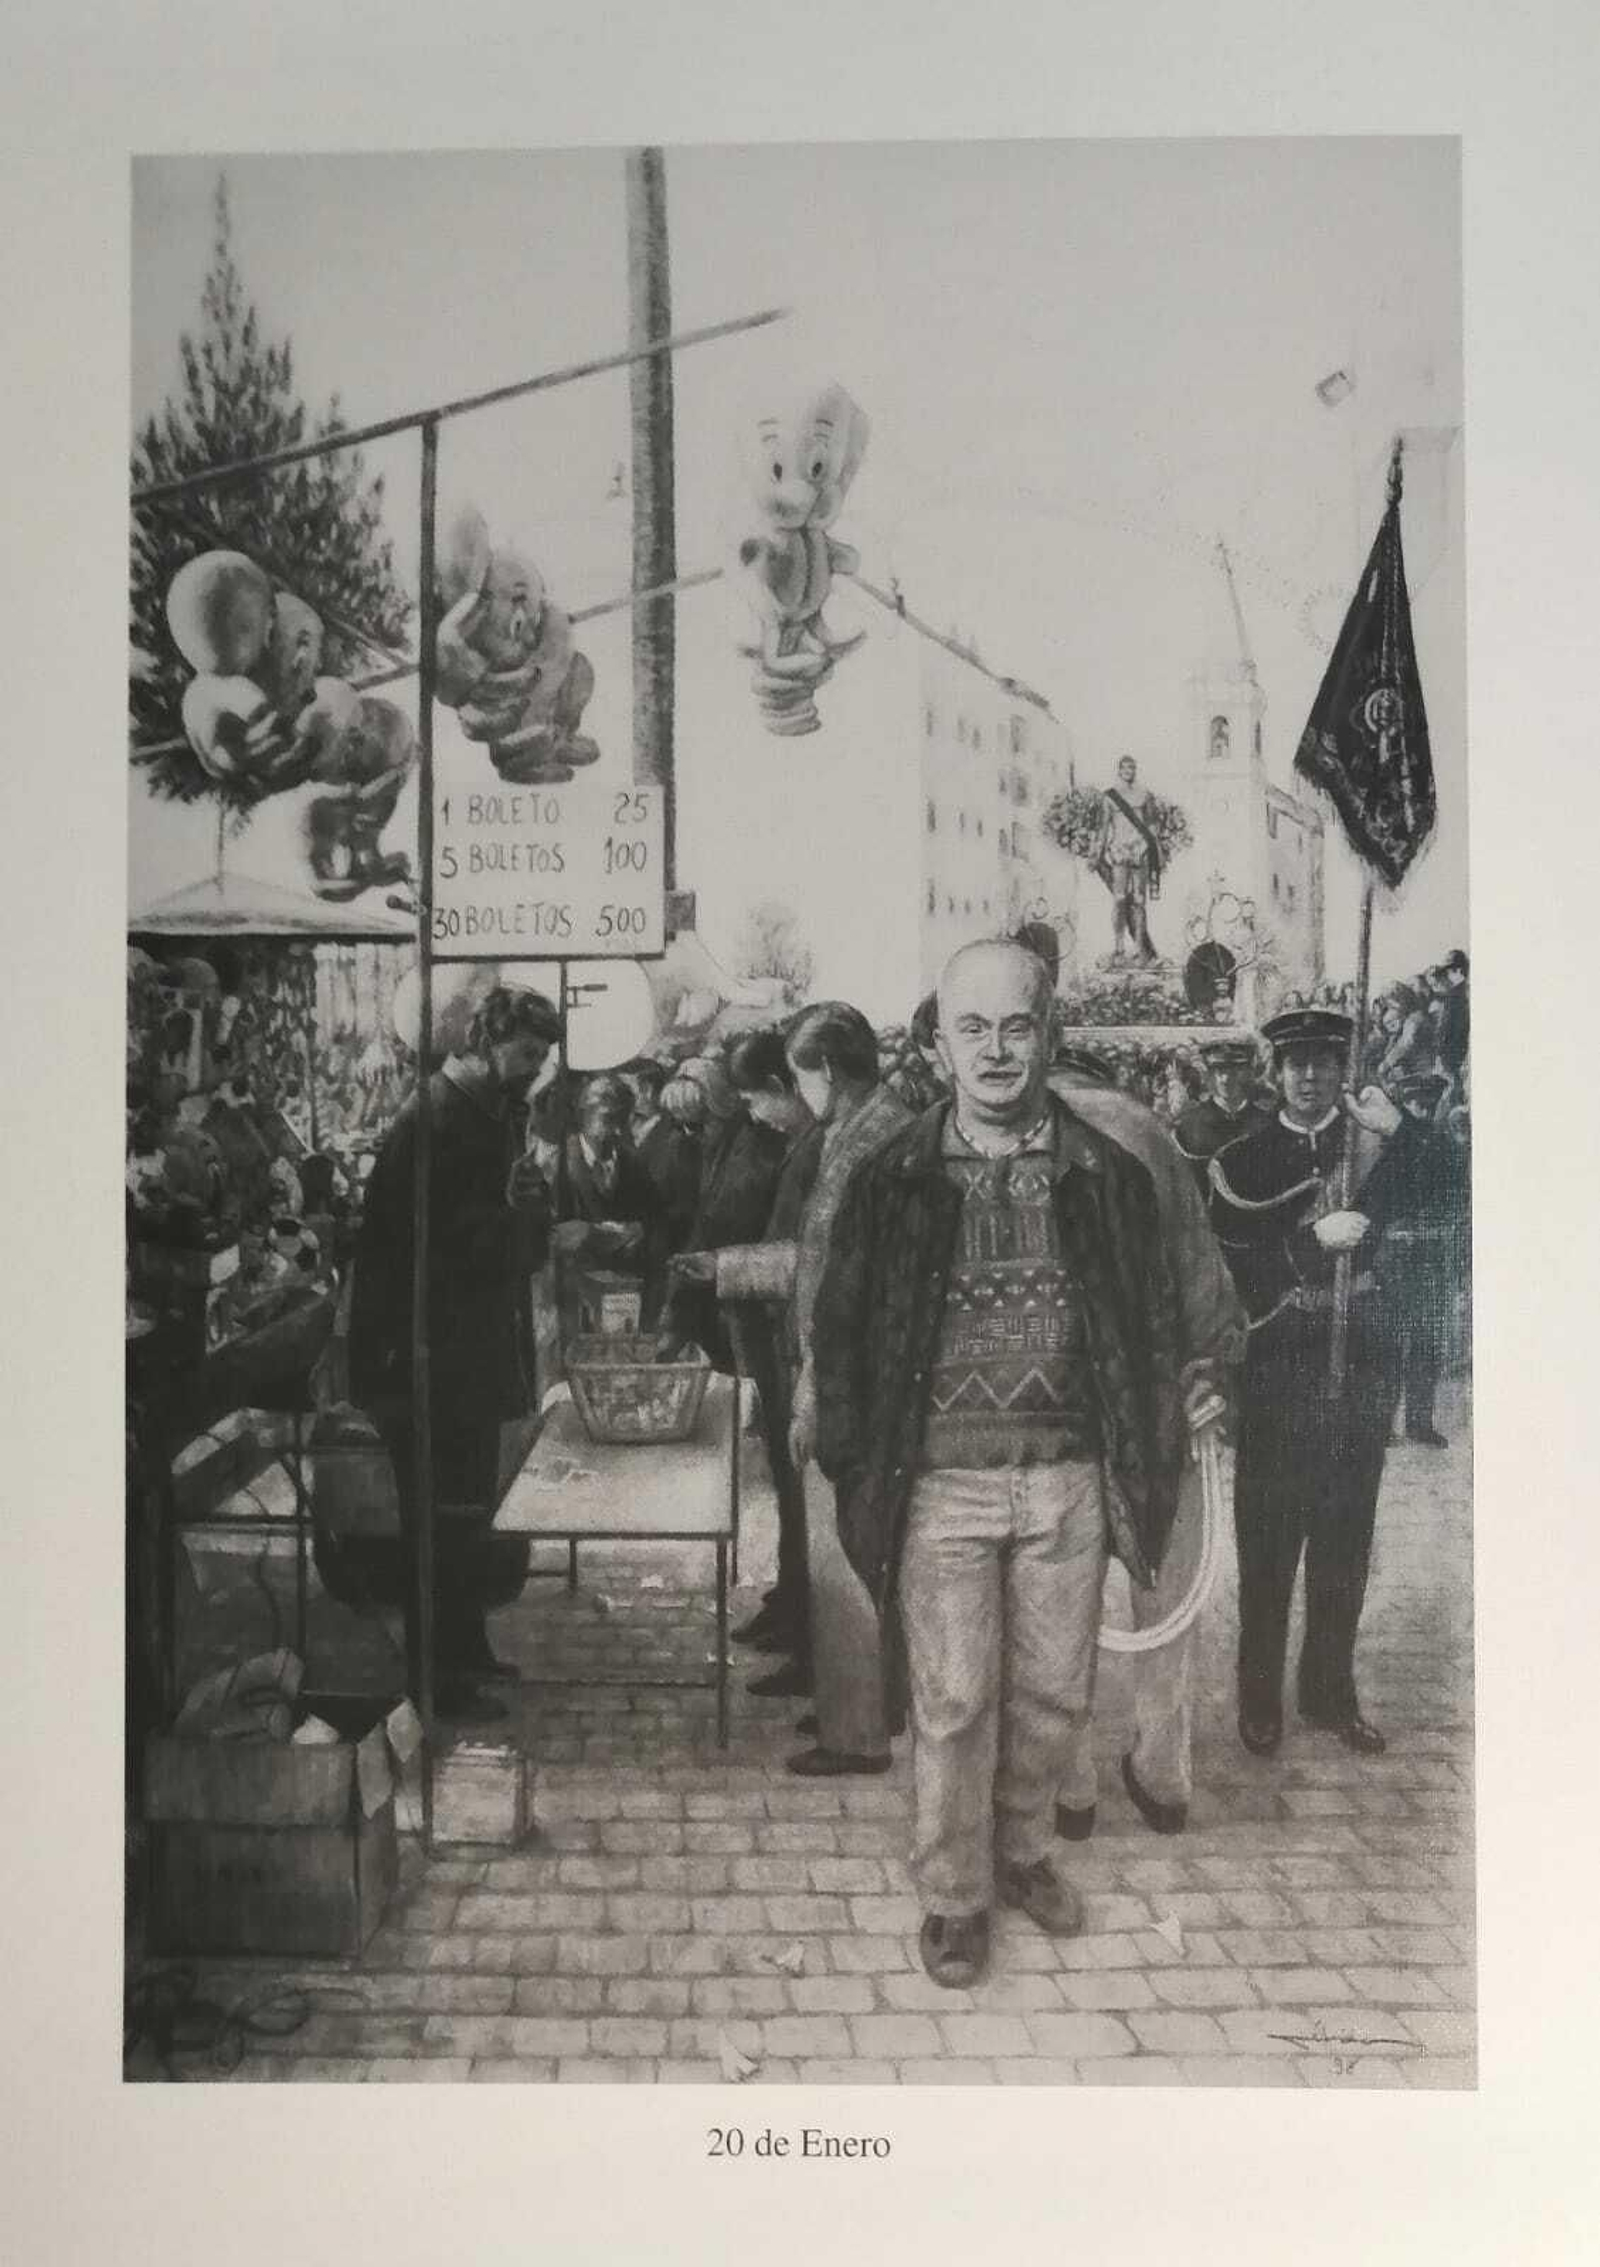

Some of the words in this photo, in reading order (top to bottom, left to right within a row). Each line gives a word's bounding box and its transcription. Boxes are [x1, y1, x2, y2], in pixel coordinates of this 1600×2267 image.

[441, 797, 450, 825] 1
[465, 793, 561, 825] BOLETO
[613, 791, 650, 825] 25
[439, 846, 459, 879] 5
[468, 841, 566, 874] BOLETOS
[602, 836, 648, 874] 100
[432, 907, 460, 941] 30
[464, 902, 573, 938] BOLETOS
[595, 904, 647, 938] 500
[706, 2127, 745, 2157] 20
[754, 2128, 790, 2157] de
[800, 2128, 892, 2158] Enero
